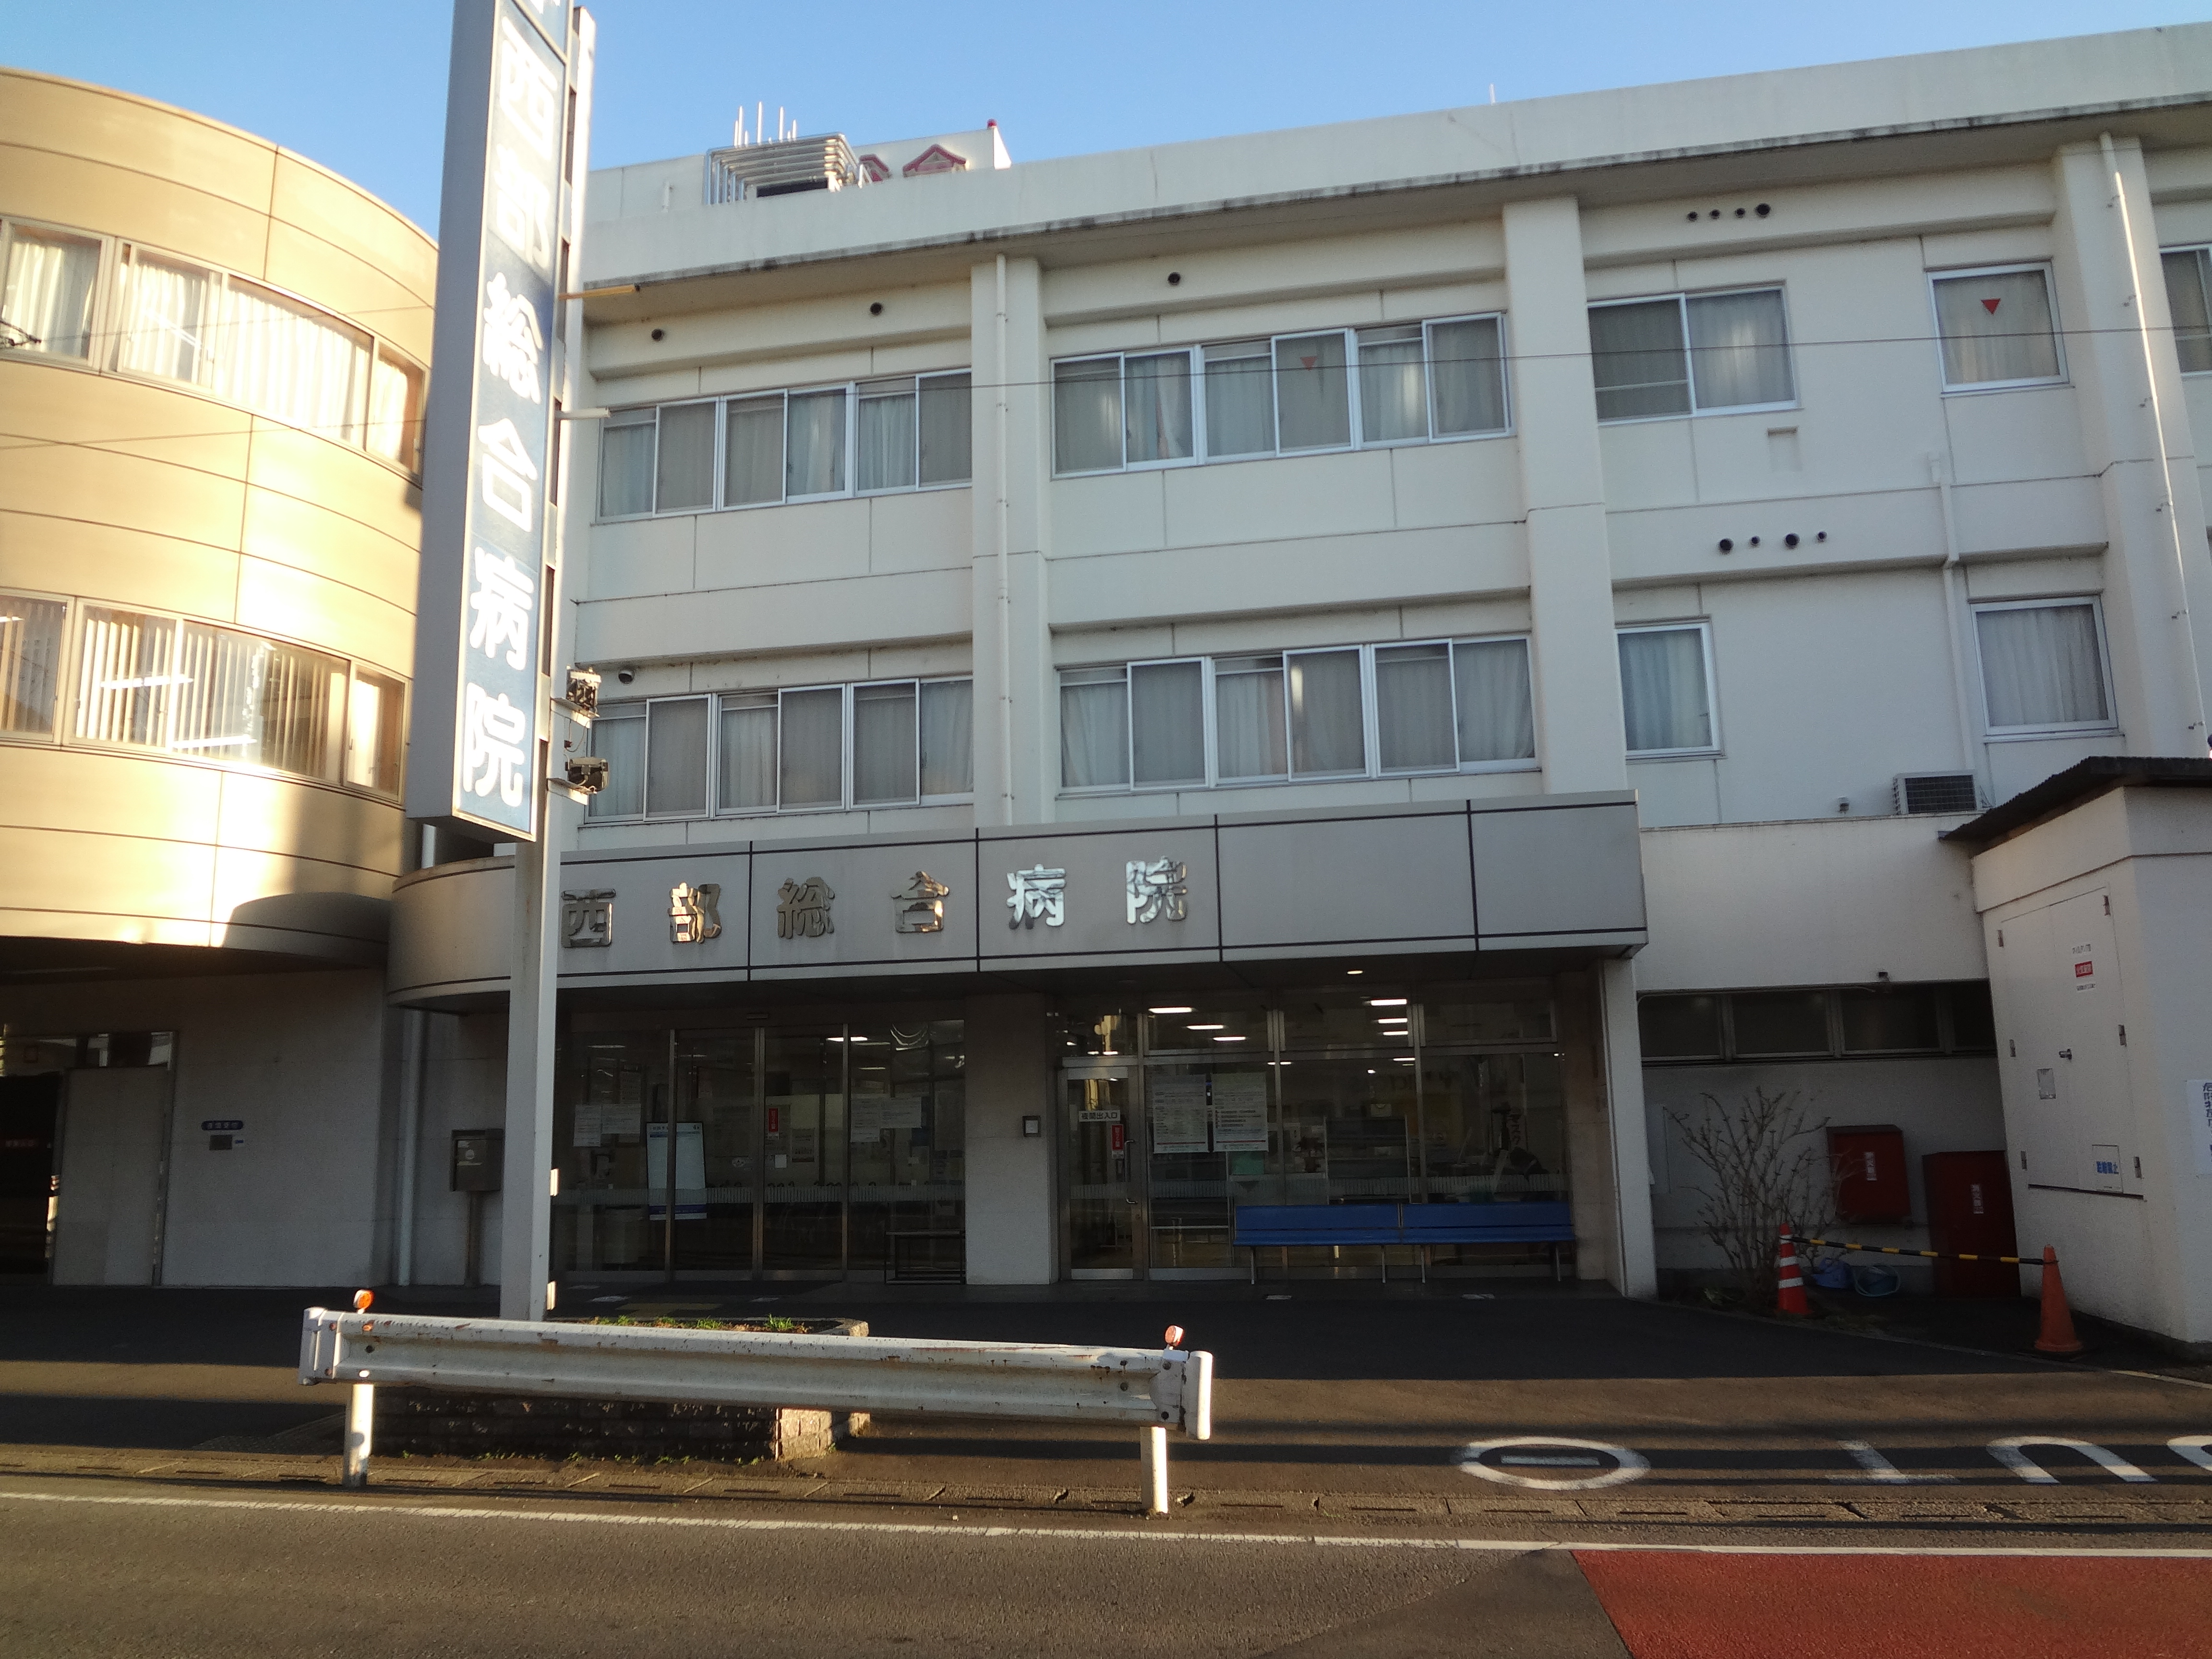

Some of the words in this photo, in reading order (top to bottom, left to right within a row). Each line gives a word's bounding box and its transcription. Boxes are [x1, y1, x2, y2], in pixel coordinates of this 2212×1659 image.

[461, 15, 558, 807] 西部総合病院
[560, 855, 1188, 948] 西部総合病院
[1082, 1112, 1118, 1120] 夜間出入口
